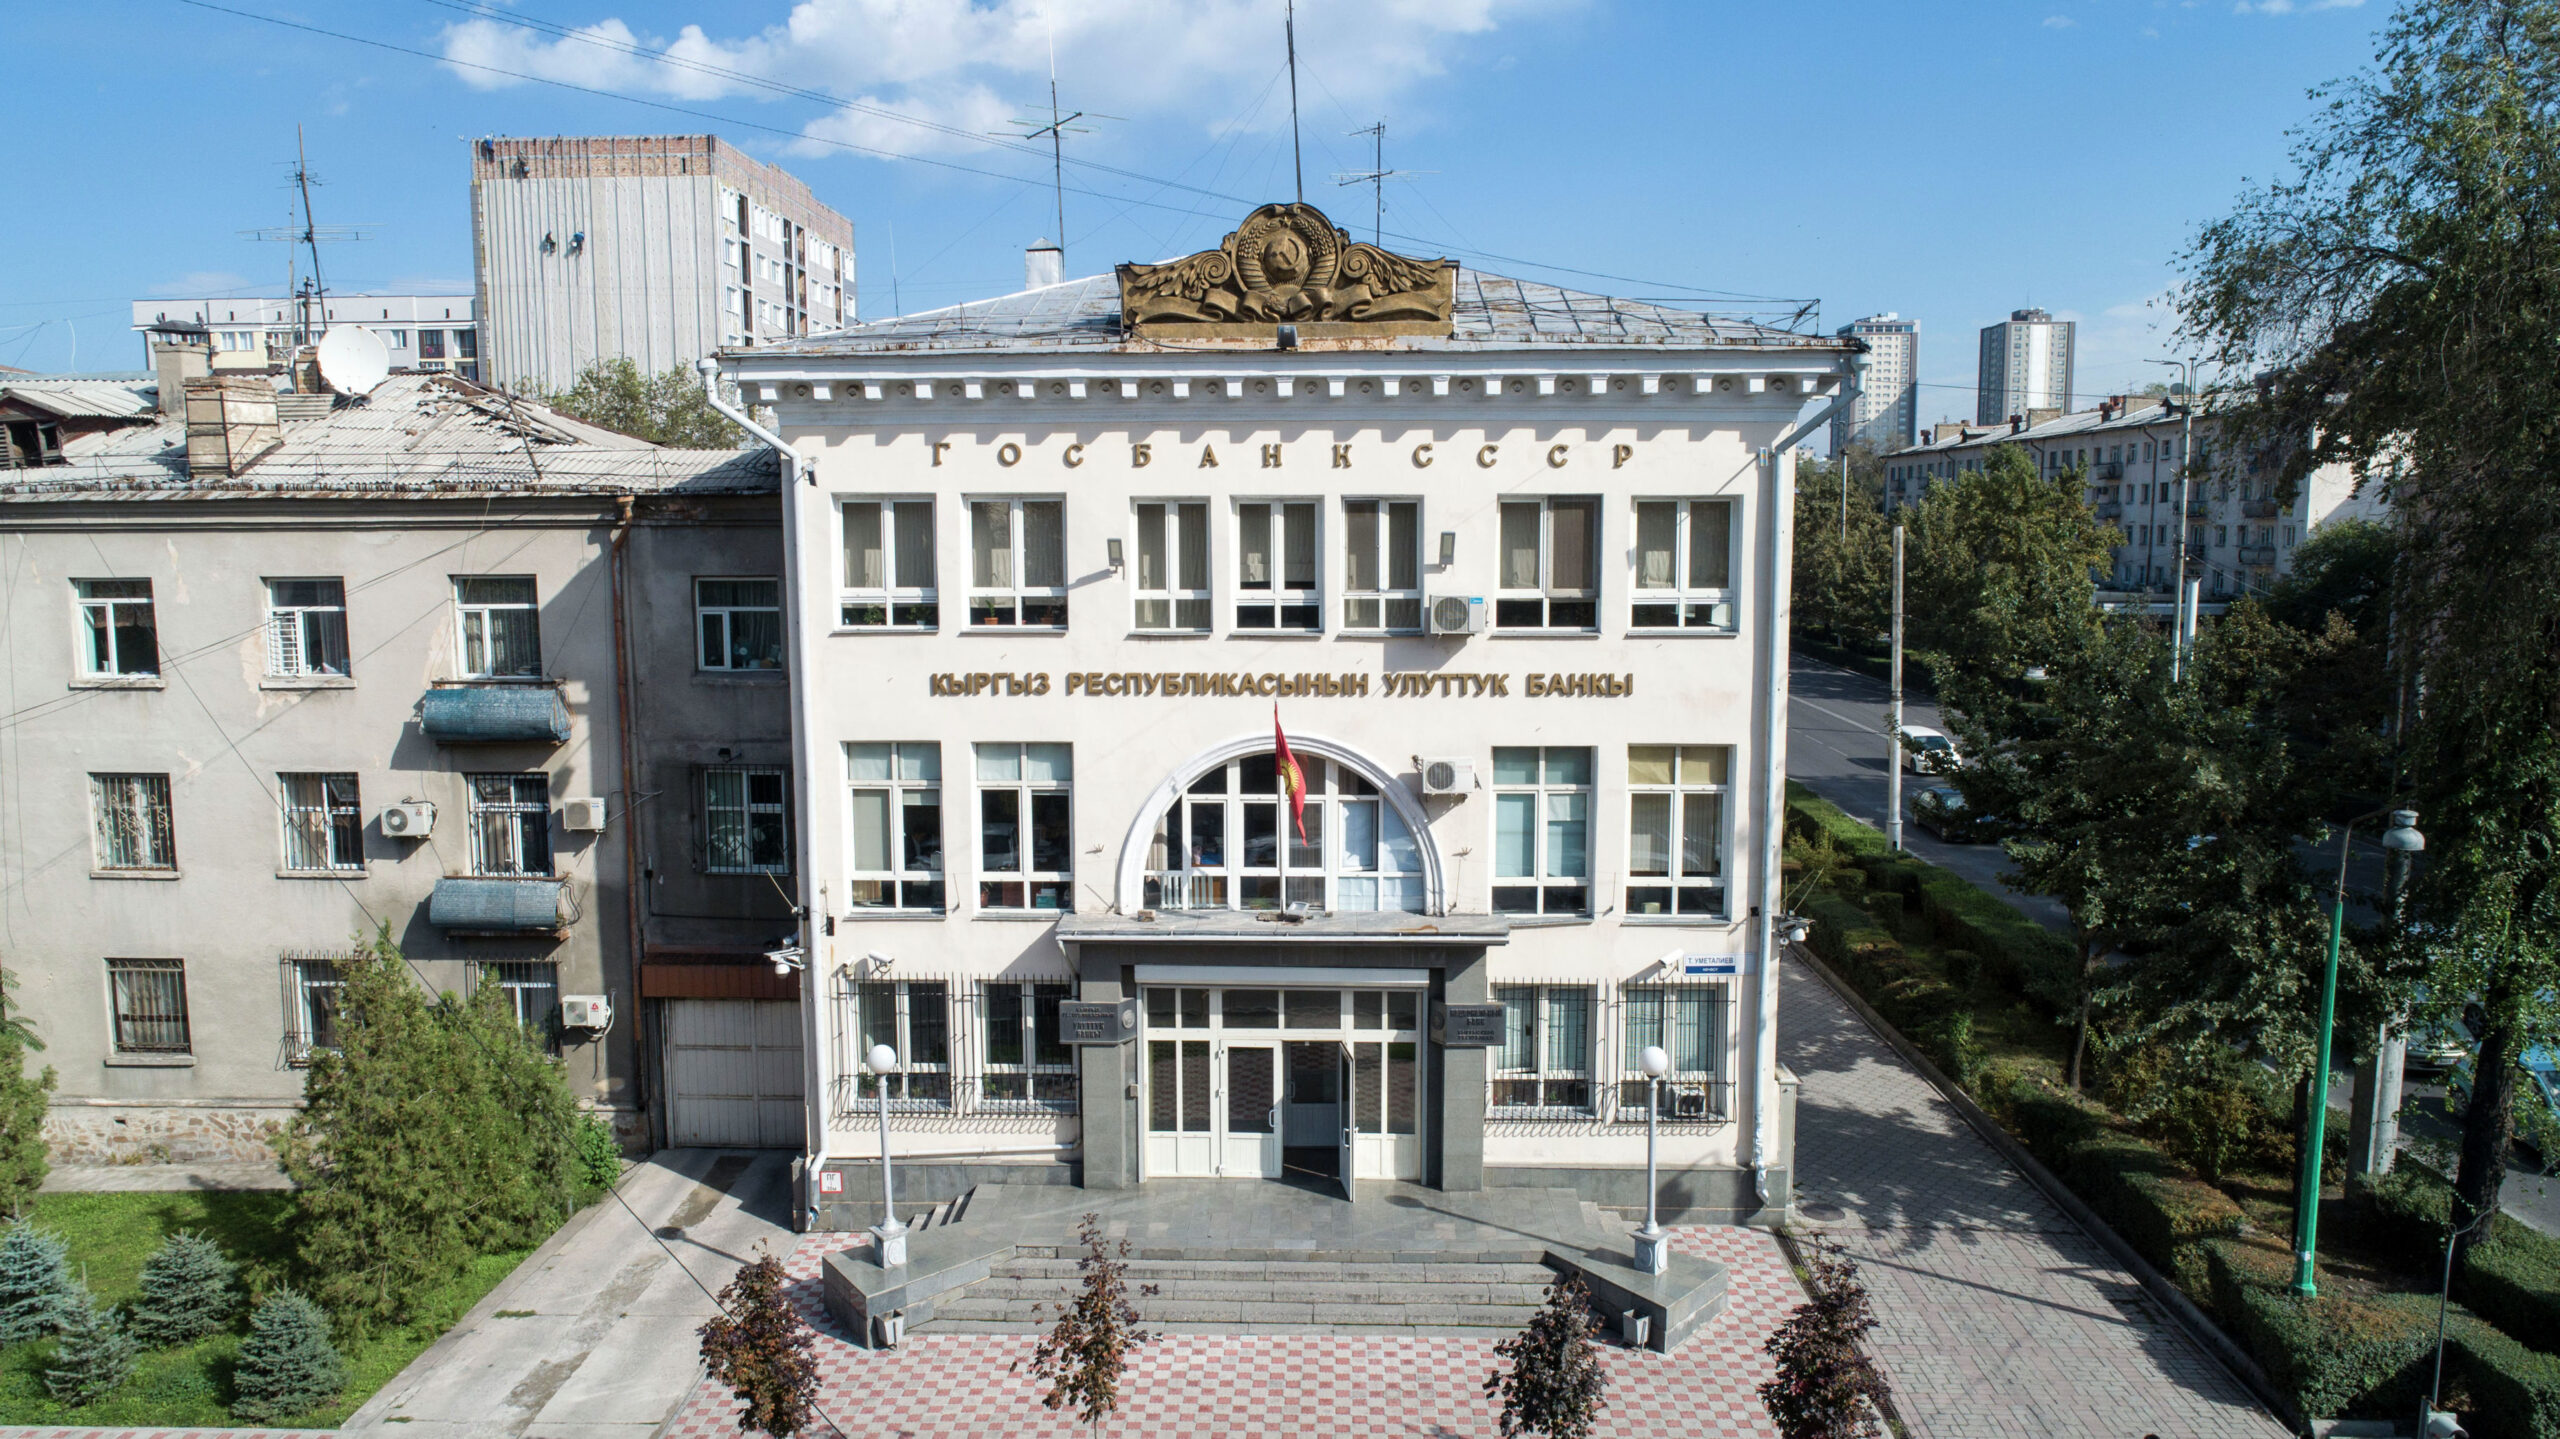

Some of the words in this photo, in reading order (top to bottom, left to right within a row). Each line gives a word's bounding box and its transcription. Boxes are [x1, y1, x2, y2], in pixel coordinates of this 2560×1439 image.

[929, 672, 1051, 696] КЫРГЫЗ
[1065, 672, 1369, 697] РЕСПУБЛИКАСЫНЫН
[1383, 673, 1509, 697] УЛУТТУК
[1525, 673, 1634, 697] БАНКЫ
